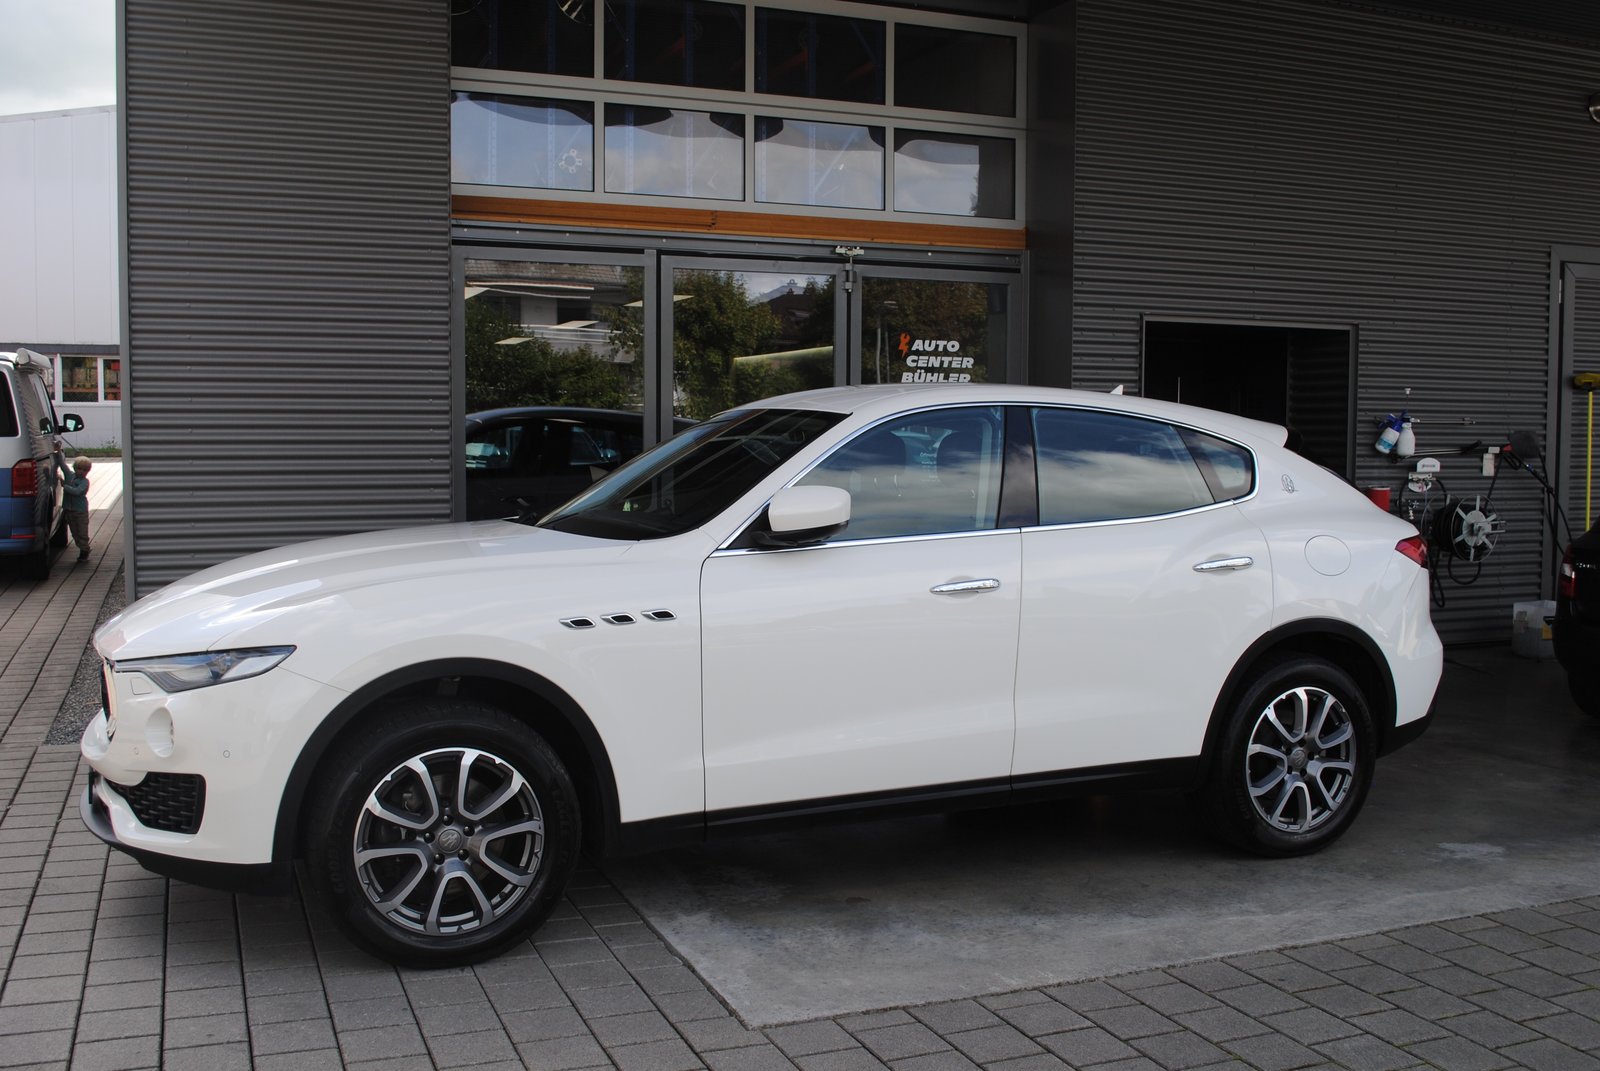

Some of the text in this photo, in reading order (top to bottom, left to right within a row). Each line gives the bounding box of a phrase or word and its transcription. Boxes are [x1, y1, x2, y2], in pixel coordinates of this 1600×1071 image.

[911, 339, 960, 352] AUTO
[906, 355, 974, 368] CENTER
[901, 369, 971, 383] BÜHLER
